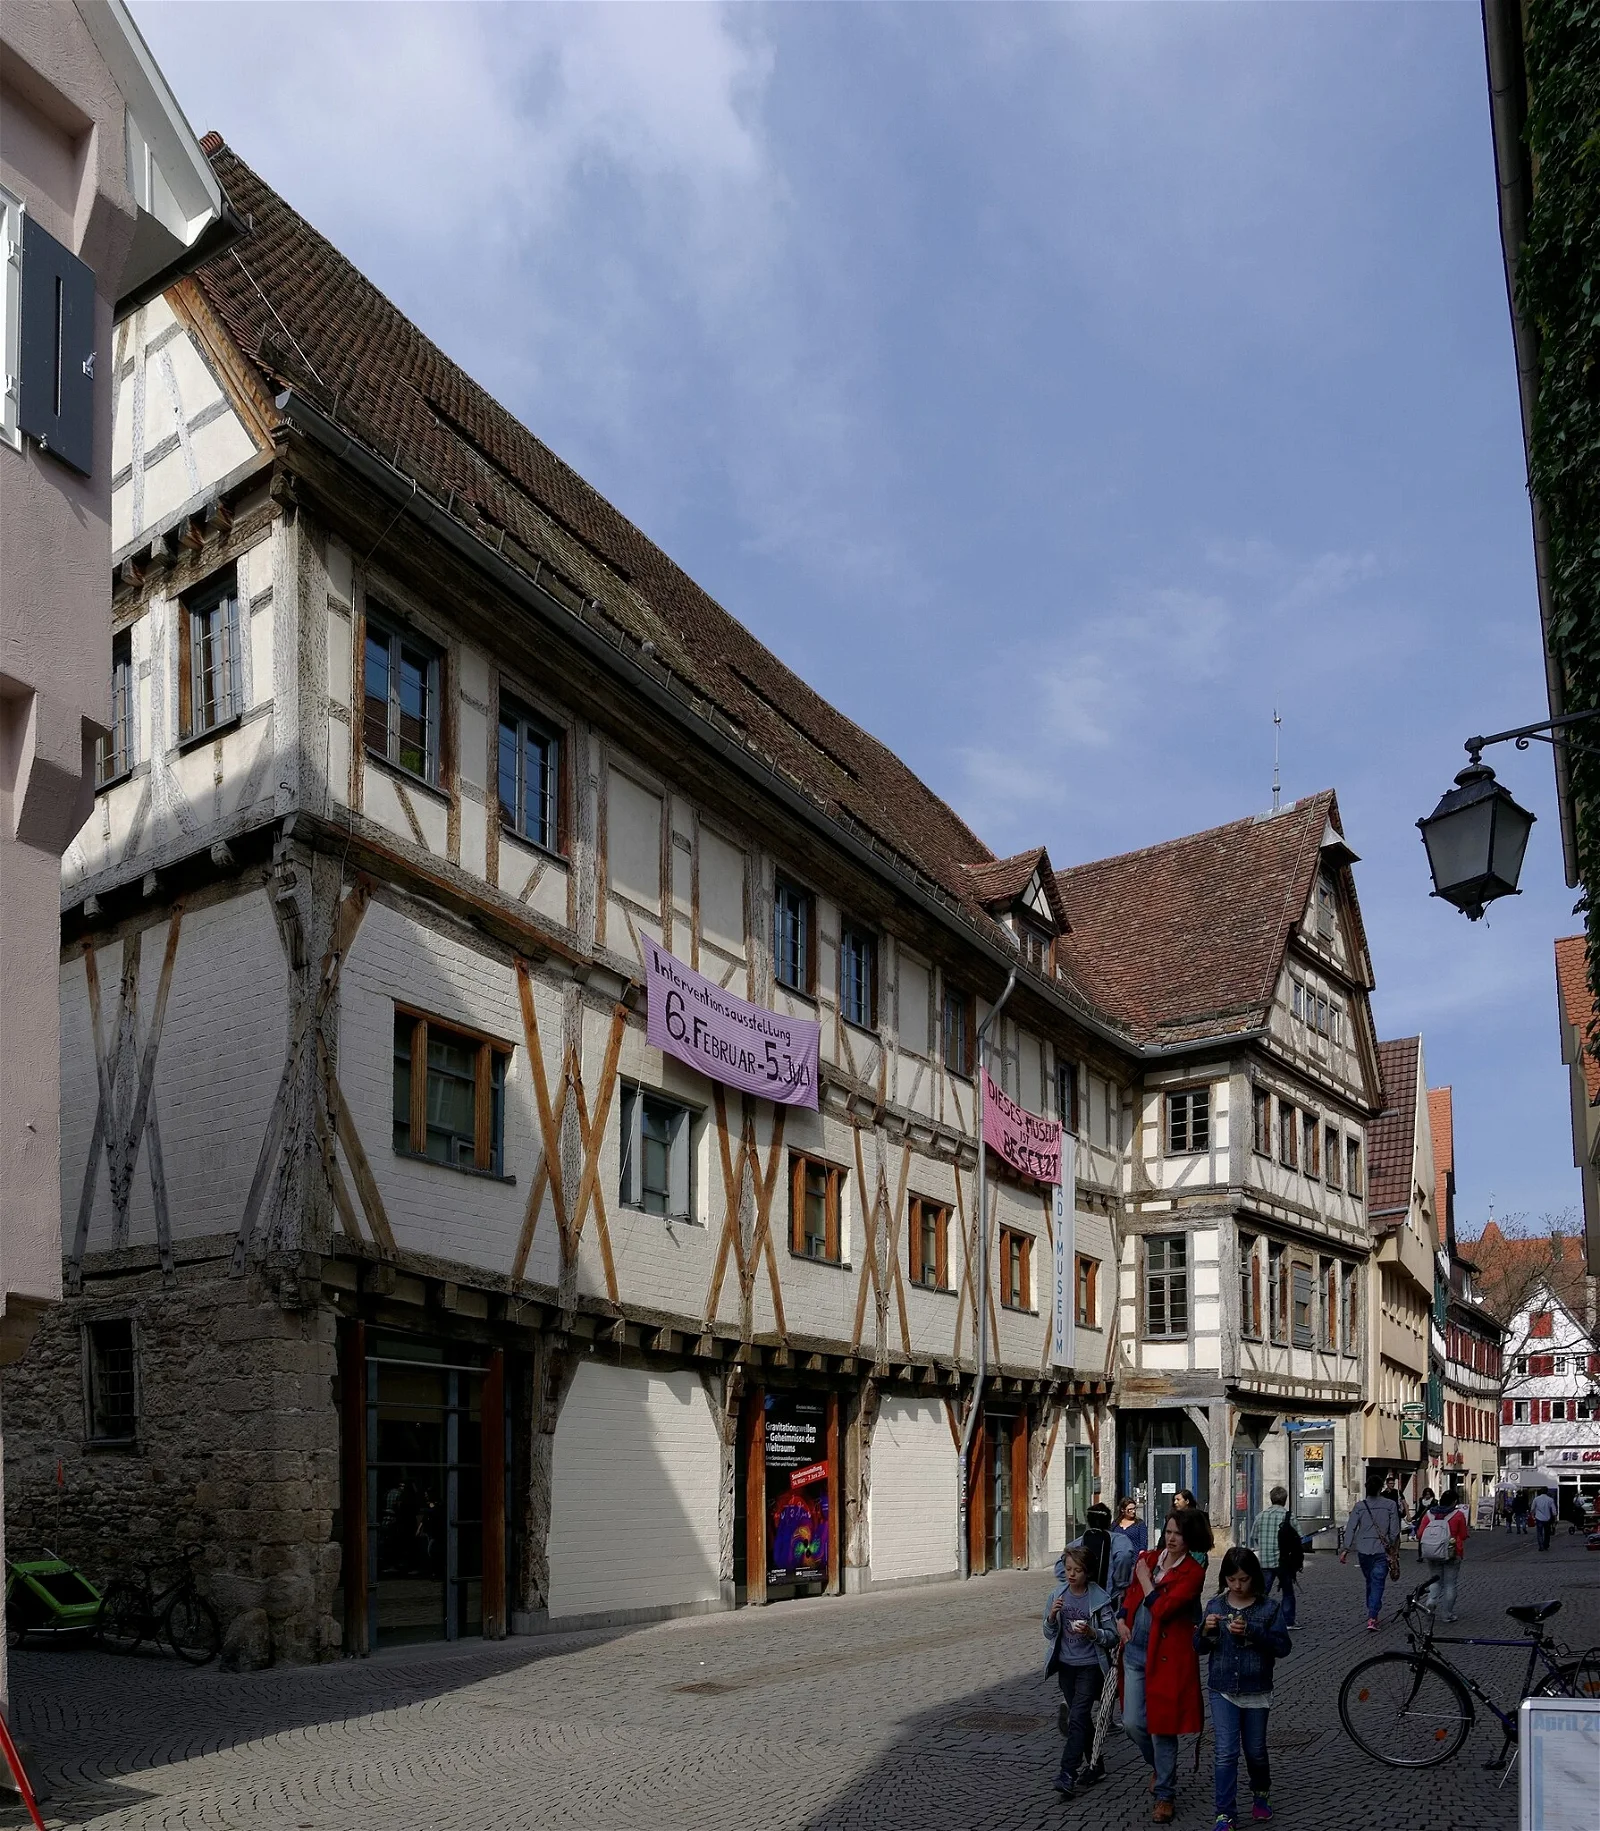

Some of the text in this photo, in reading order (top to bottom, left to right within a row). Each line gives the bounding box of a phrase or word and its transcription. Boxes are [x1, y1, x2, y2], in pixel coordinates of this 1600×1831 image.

[652, 950, 792, 1047] Interventionsausstellung
[987, 1075, 1060, 1143] DIESES MUSEUM
[1019, 1130, 1030, 1146] IST
[1003, 1129, 1059, 1177] BESETZT
[1055, 1186, 1064, 1355] ADTMUSEUM
[765, 1421, 817, 1434] Gravitationswellen
[770, 1432, 805, 1443] Geheimnisse
[805, 1433, 816, 1444] des
[765, 1442, 796, 1453] Weltraums
[1562, 1451, 1579, 1461] EIS
[1533, 1714, 1578, 1732] April
